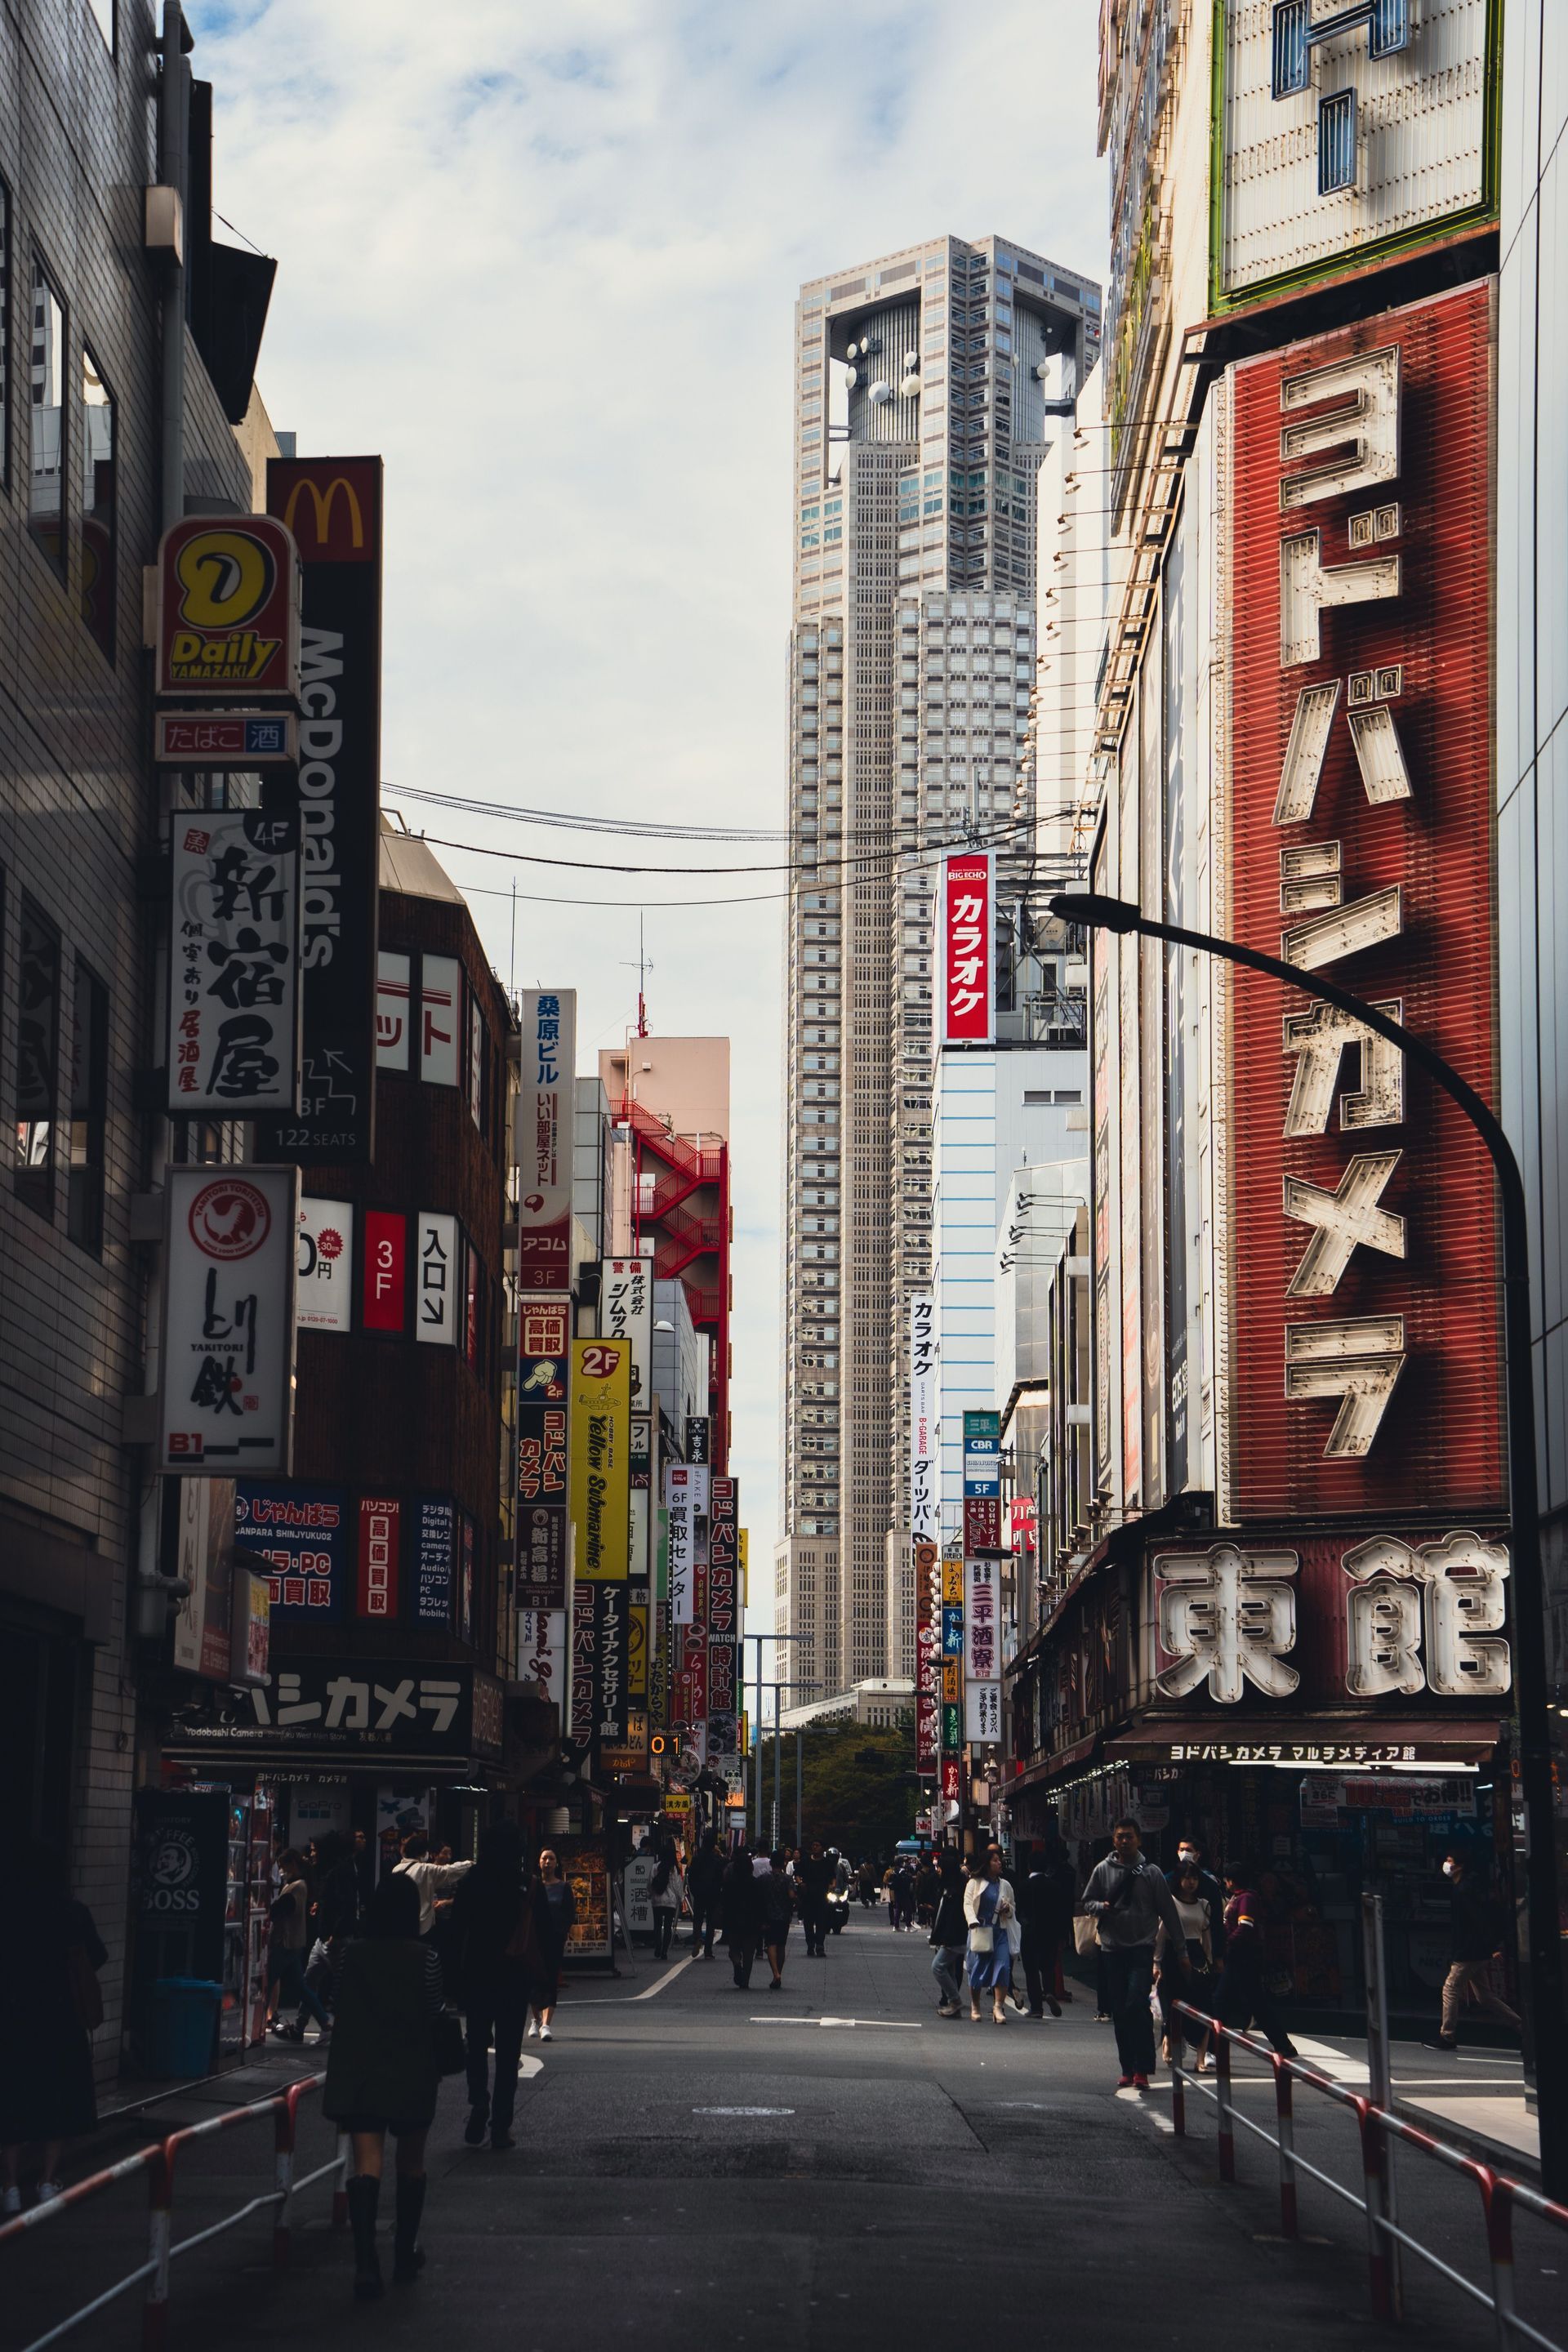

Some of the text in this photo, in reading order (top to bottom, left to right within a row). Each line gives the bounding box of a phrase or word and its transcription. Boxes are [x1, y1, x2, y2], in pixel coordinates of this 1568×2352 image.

[172, 632, 283, 679] Daily
[171, 664, 249, 679] YAMAZAKI
[168, 725, 240, 749] たばこ
[251, 724, 280, 749] 酒
[299, 626, 344, 969] McDonald's
[253, 821, 290, 846] 4F
[948, 871, 987, 880] BIG ECHO
[1272, 342, 1414, 1459] ヨドバシカメラ
[180, 920, 203, 1005] 個室あり
[950, 894, 984, 1017] カラオケ
[207, 846, 290, 1098] 新宿屋
[178, 1009, 201, 1093] 居酒屋
[537, 995, 559, 1085] 桑原ビル
[276, 1129, 356, 1146] 122 SEATS
[536, 1093, 550, 1187] いい部屋ネット
[195, 1185, 228, 1217] YAKITORI
[523, 1236, 567, 1251] アコム
[375, 1241, 394, 1300] 3F
[423, 1229, 448, 1291] 入口
[612, 1262, 642, 1274] 警備
[533, 1270, 556, 1285] 3F
[630, 1275, 645, 1315] 株式会社
[528, 1319, 561, 1335] 高価
[913, 1303, 933, 1376] カラオケ
[191, 1343, 243, 1352] YAKITORI
[528, 1337, 561, 1352] 買取
[581, 1347, 619, 1375] 2F
[547, 1384, 564, 1398] 2F
[169, 1433, 203, 1453] B1
[691, 1435, 704, 1463] 吉永
[919, 1417, 927, 1455] B-GARAGE
[971, 1440, 993, 1450] CBR
[542, 1410, 565, 1492] ヨドバシ
[519, 1437, 541, 1499] カメラ
[586, 1414, 608, 1570] Yellow Submarine
[672, 1492, 688, 1503] 6F
[913, 1459, 933, 1531] ダーツバー
[974, 1484, 991, 1494] 5F
[252, 1498, 341, 1528] じゃんぱら
[421, 1517, 448, 1527] Digital
[236, 1526, 274, 1537] JANPARA
[370, 1517, 390, 1614] 高価買取
[671, 1507, 688, 1616] 買取センター
[710, 1478, 735, 1632] ヨドバシカメラ
[420, 1586, 431, 1594] PC
[419, 1608, 446, 1619] Mobile
[1153, 1530, 1512, 1703] 東館
[708, 1633, 736, 1644] WATCH
[571, 1584, 595, 1748] ヨドバシカメラ
[599, 1586, 621, 1737] ケータイアクセサリー館
[650, 1657, 665, 1723] おたからや
[710, 1645, 733, 1711] 時計館
[185, 1726, 229, 1738] Yodobashi
[230, 1727, 264, 1738] Camera
[329, 1731, 347, 1740] Store
[1170, 1745, 1417, 1762] ヨドバシカメラ マルチメディア館
[256, 1773, 311, 1783] ヨドバシカメラ
[297, 1800, 342, 1811] GoPro
